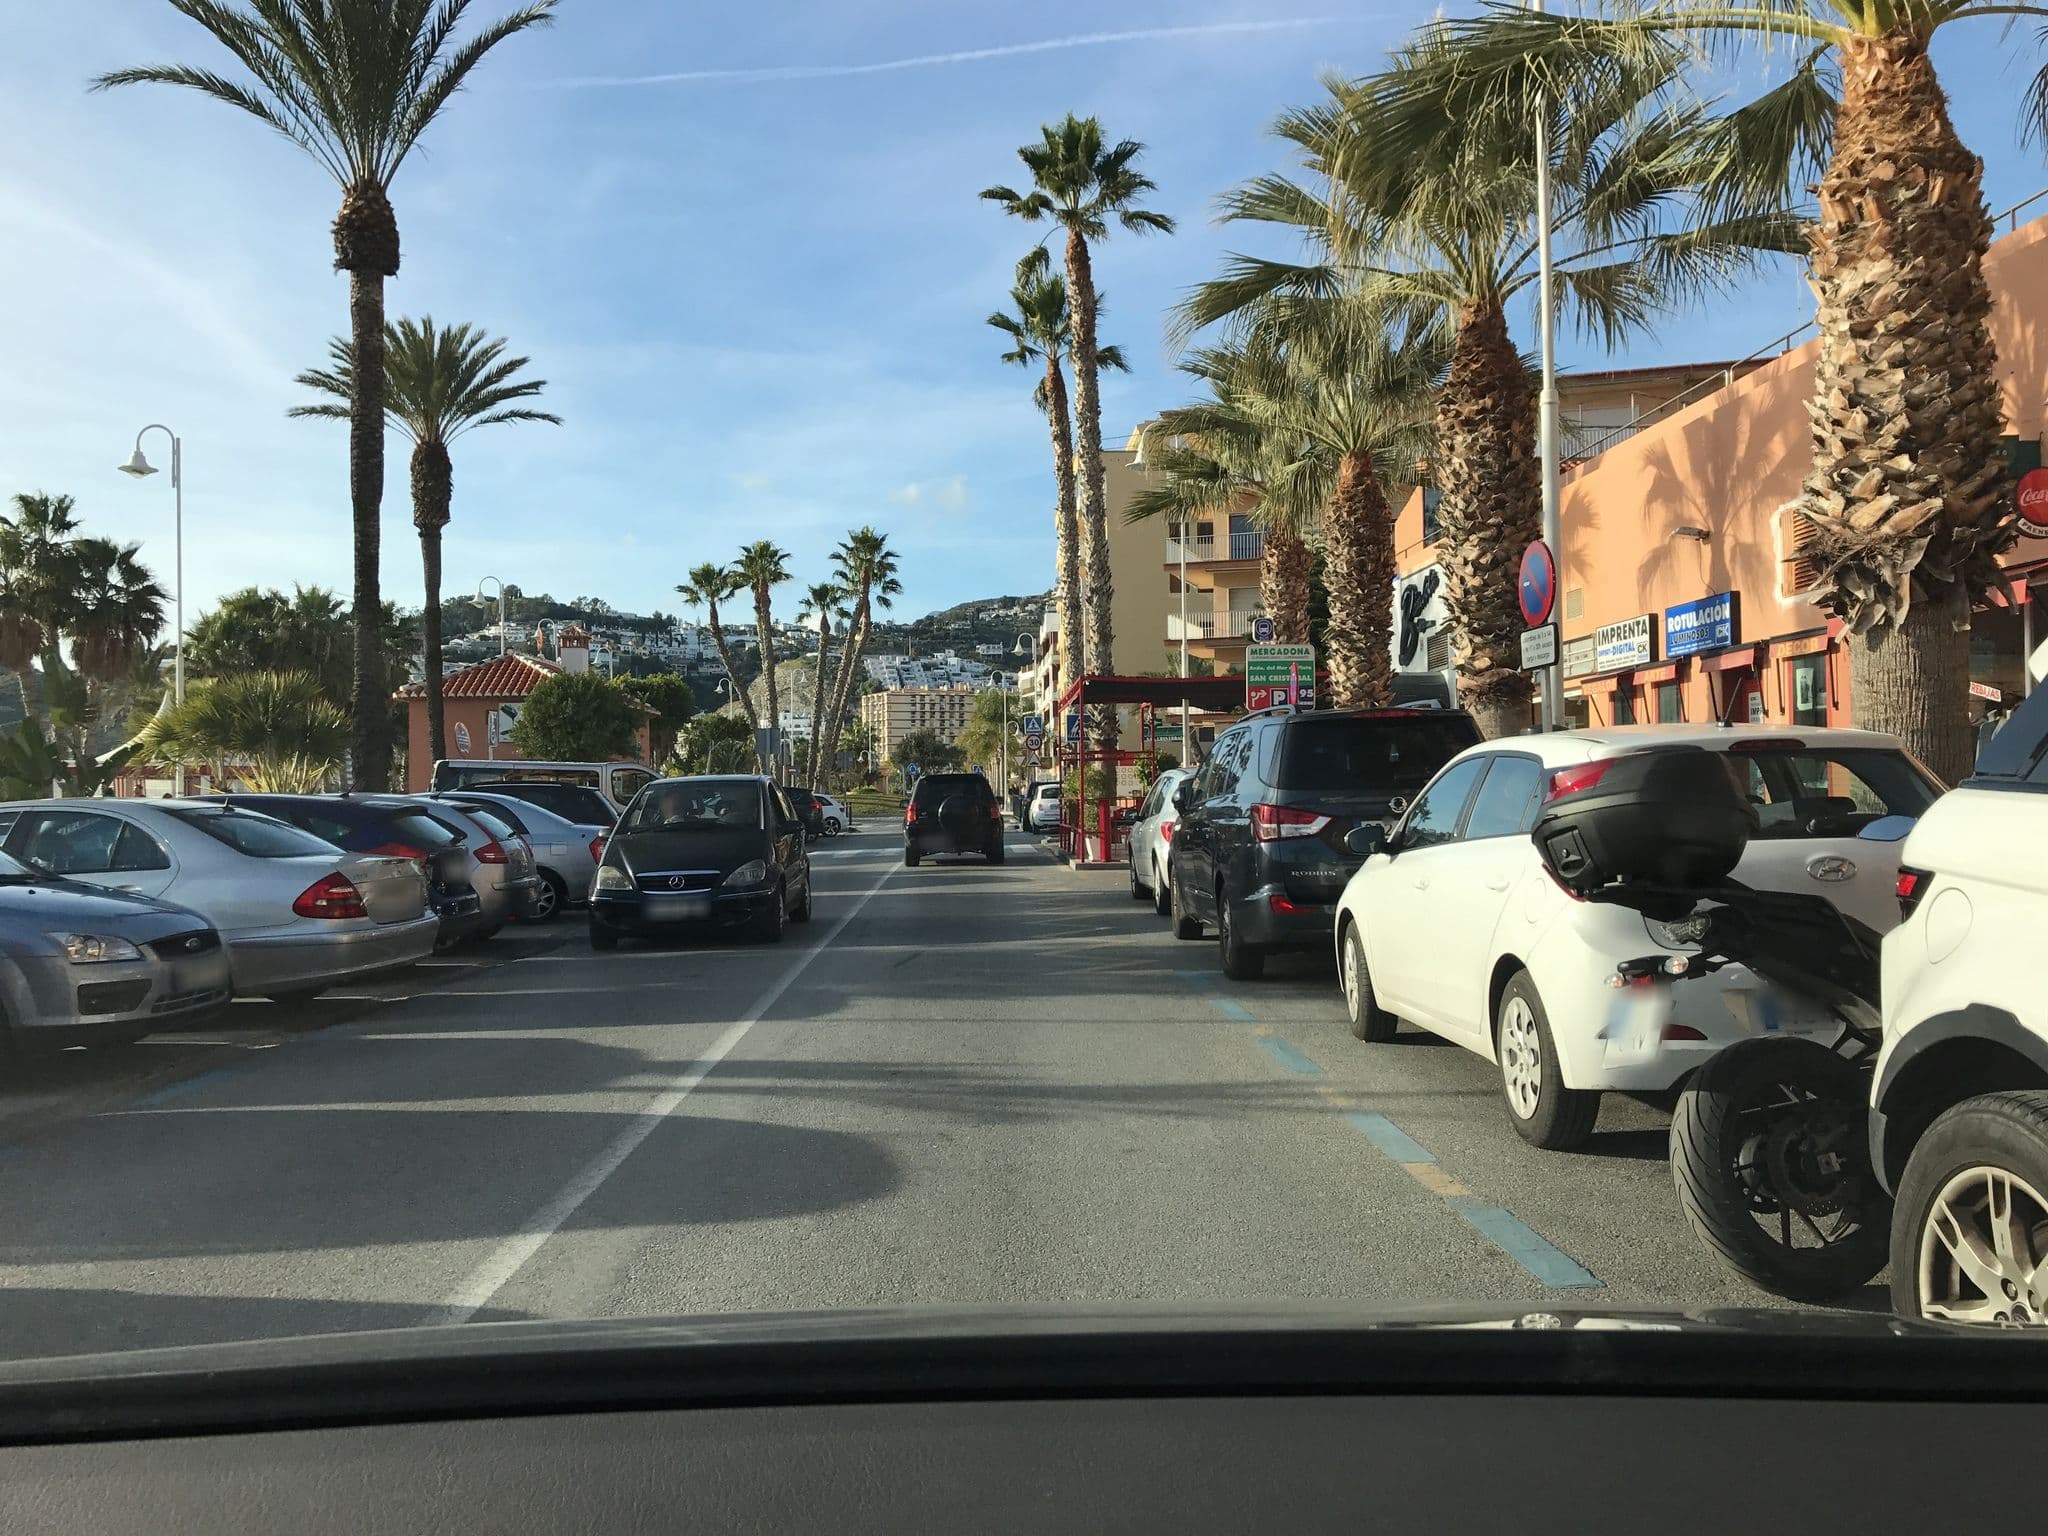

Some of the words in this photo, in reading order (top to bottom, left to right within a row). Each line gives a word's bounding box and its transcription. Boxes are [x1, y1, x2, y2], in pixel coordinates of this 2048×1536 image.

[1667, 600, 1730, 633] ROTULACIÓN
[1597, 618, 1649, 646] IMPRENTA
[1671, 626, 1709, 646] LUMINOSOS
[1250, 647, 1310, 656] MERCADONA
[1249, 674, 1267, 682] SAN
[1300, 688, 1314, 698] 95
[1028, 738, 1040, 747] 30
